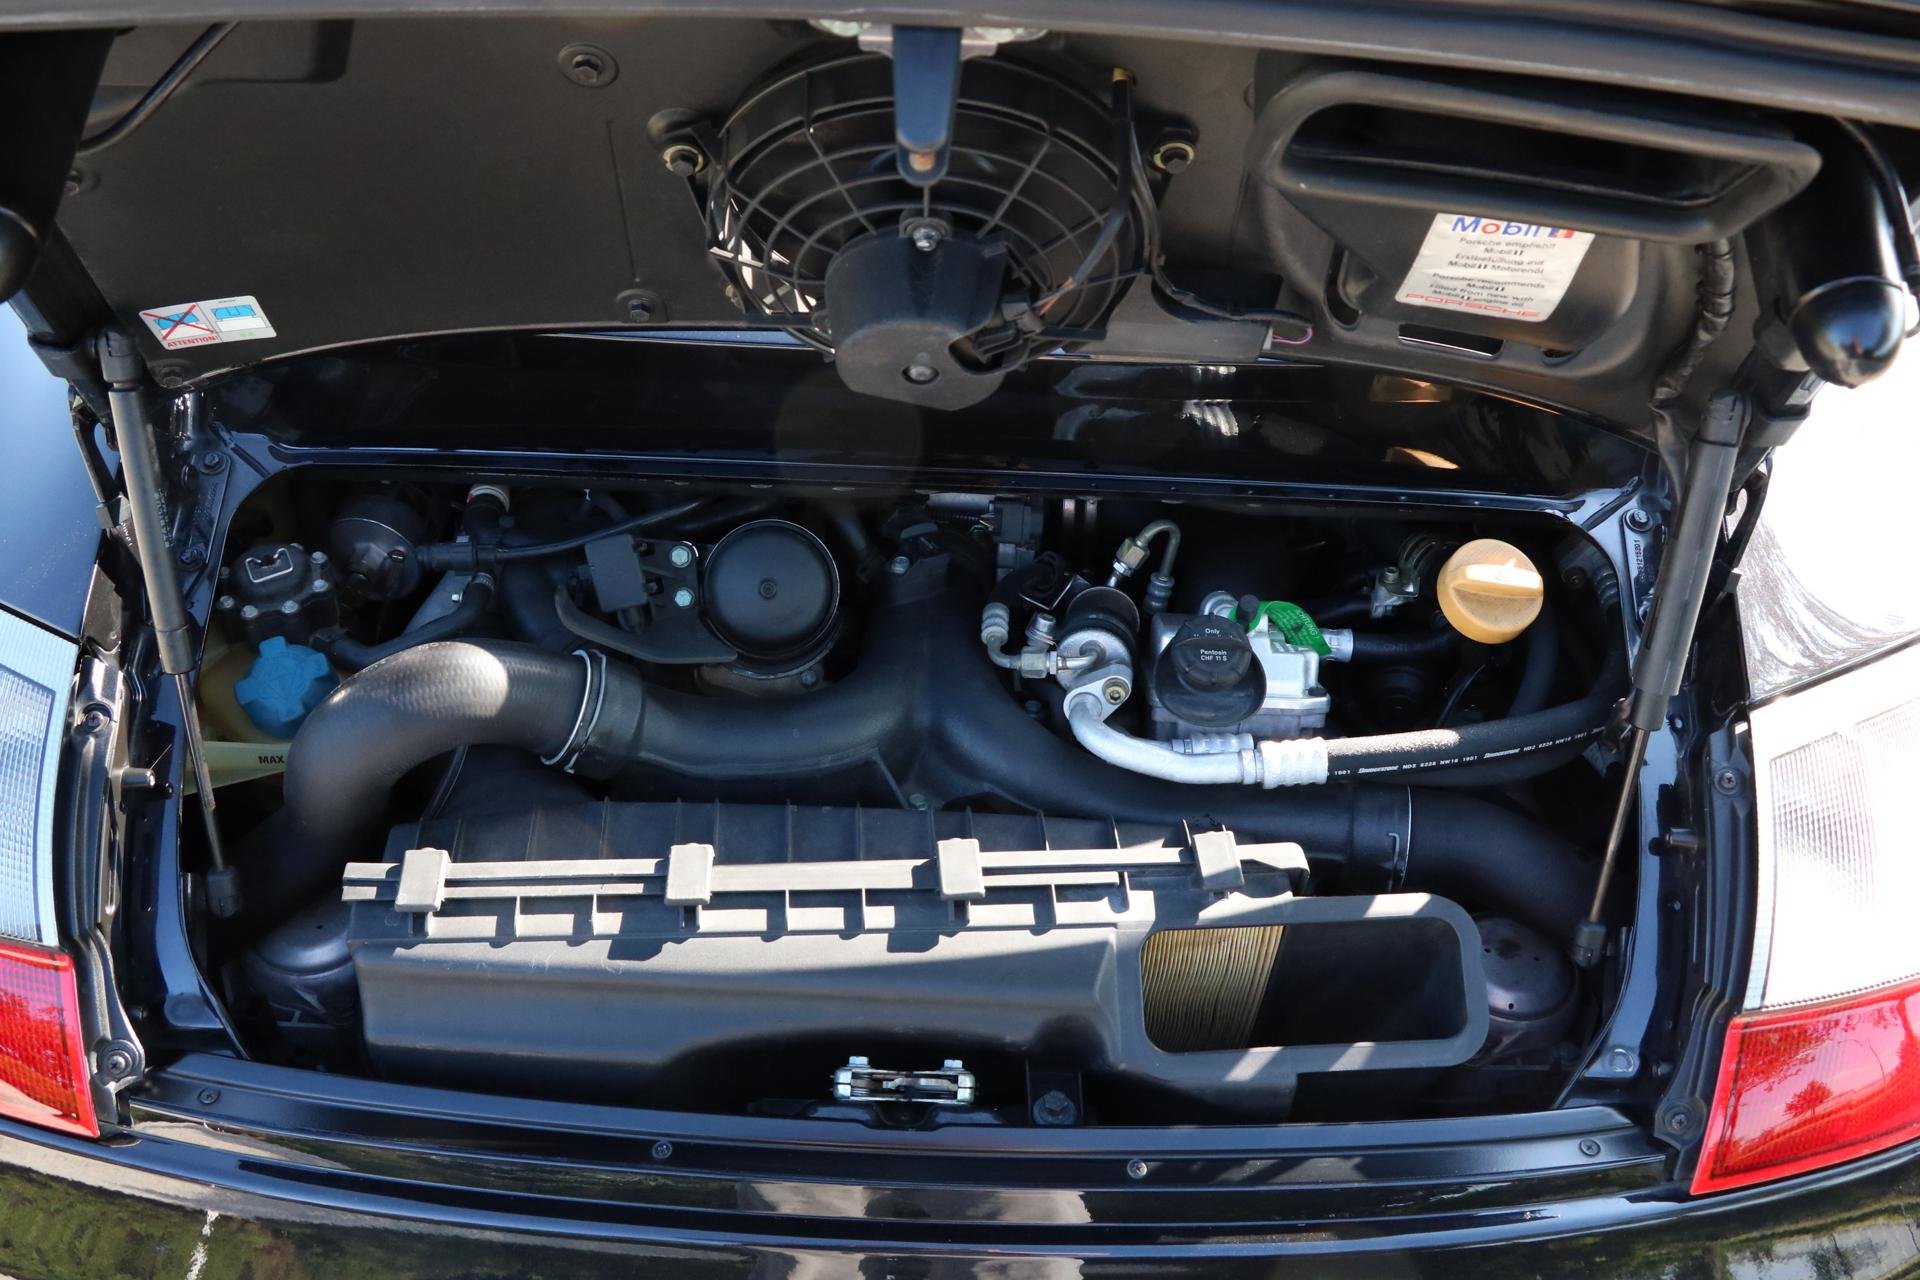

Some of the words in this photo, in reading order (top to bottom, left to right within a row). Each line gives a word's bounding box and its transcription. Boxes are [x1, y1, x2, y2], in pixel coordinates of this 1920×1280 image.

[1459, 237, 1502, 247] Porsche
[1447, 261, 1477, 270] Mobil
[1432, 272, 1475, 282] Porsche
[1477, 279, 1546, 290] recommends
[1460, 288, 1484, 297] from
[1487, 292, 1509, 300] new
[1405, 293, 1542, 317] PORSCHE
[167, 335, 219, 348] ATTENTION!
[1204, 627, 1220, 635] Only
[1200, 648, 1227, 656] Pentosin
[258, 755, 285, 764] MAX
